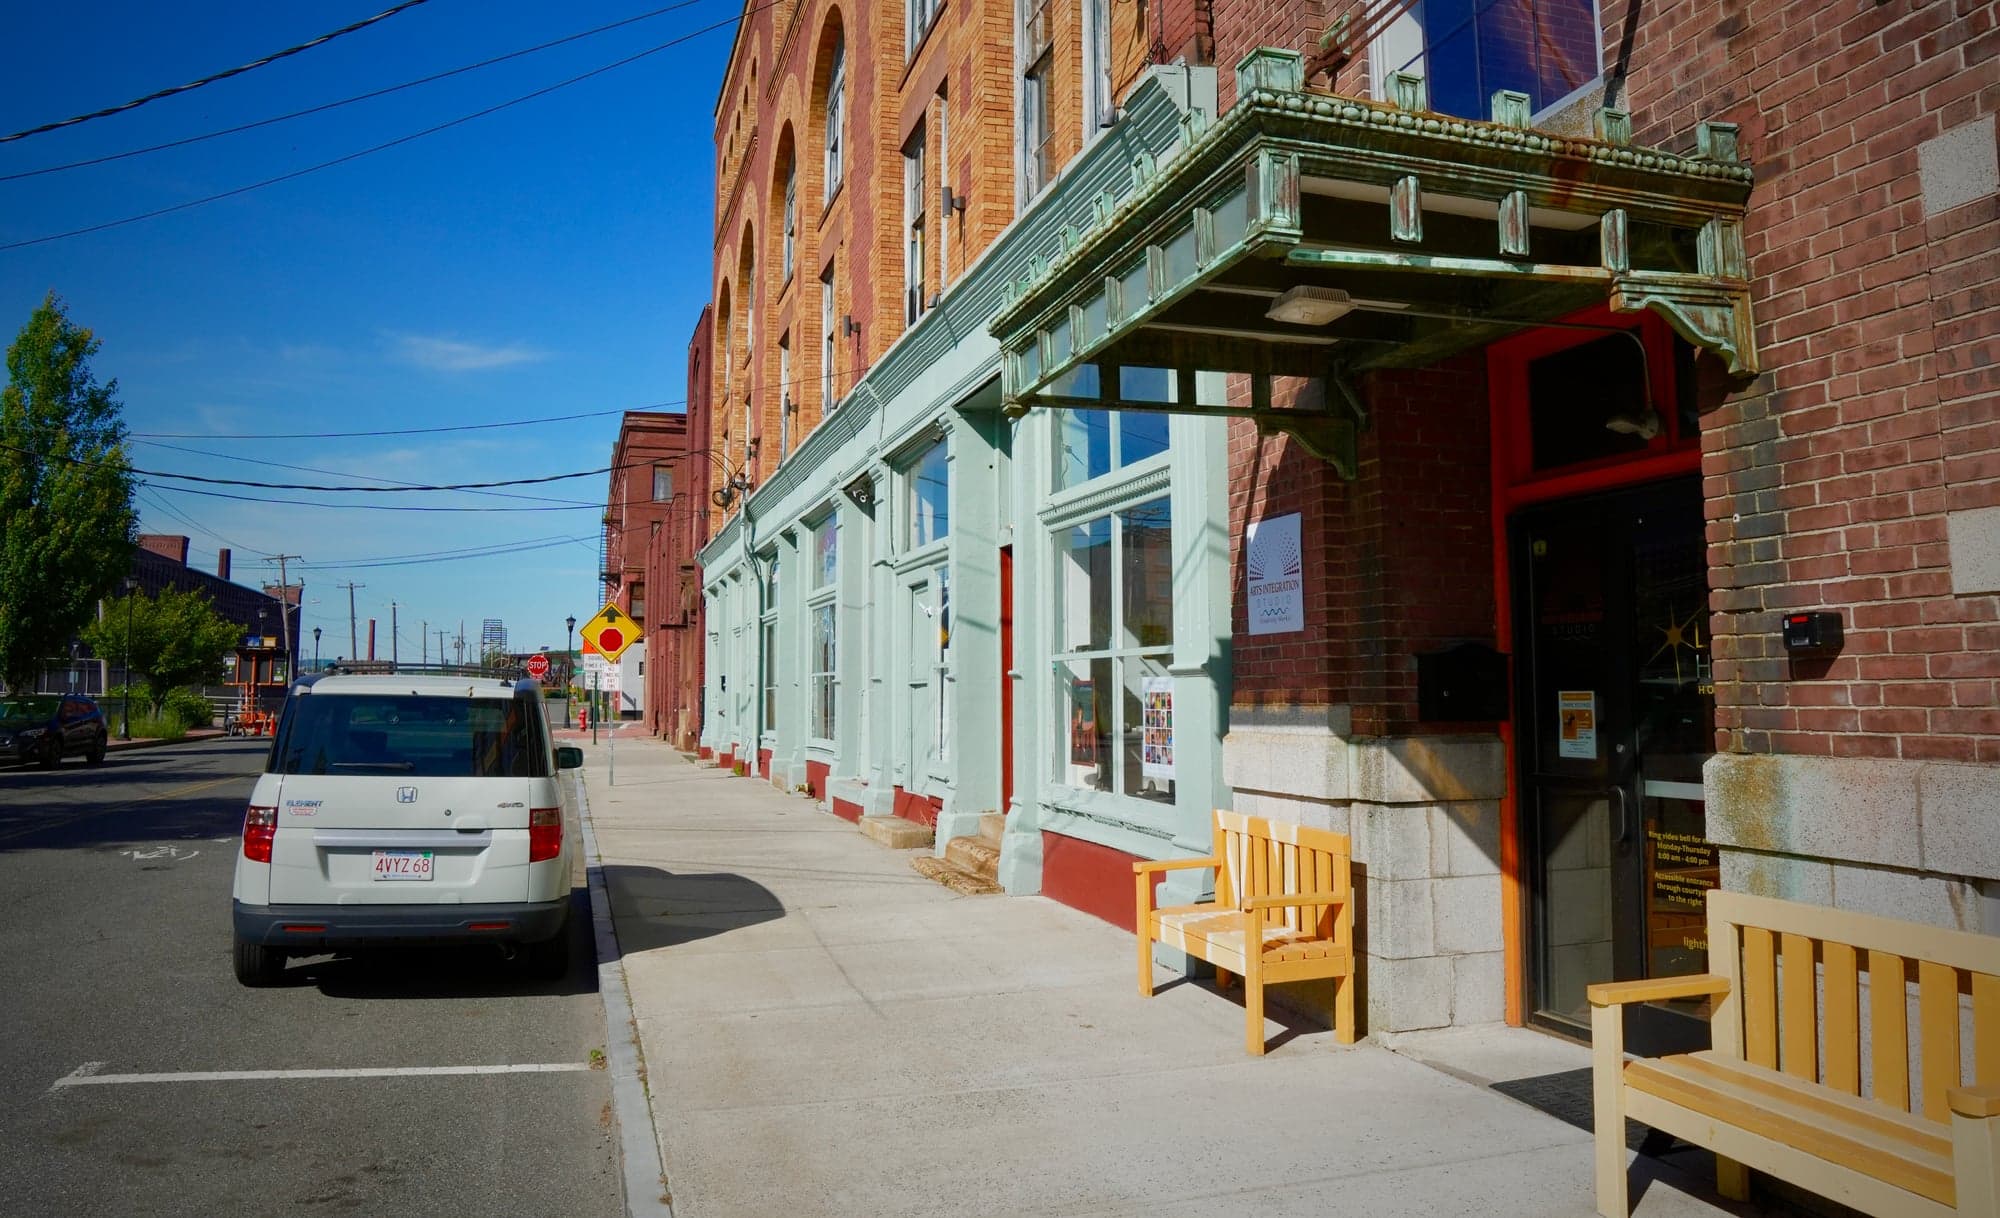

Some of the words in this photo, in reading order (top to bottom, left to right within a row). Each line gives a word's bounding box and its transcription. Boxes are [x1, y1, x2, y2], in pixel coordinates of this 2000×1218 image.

[1250, 584, 1262, 596] ARTS
[1262, 579, 1299, 594] INTEGRATION
[530, 661, 547, 669] STOP
[1662, 832, 1679, 841] video
[1680, 833, 1691, 842] bell
[1691, 835, 1701, 843] for
[1657, 841, 1711, 857] Monday-Thursday
[375, 858, 410, 873] 4VYZ
[413, 858, 430, 873] 68
[1685, 855, 1697, 864] 4:00
[1698, 859, 1709, 867] pm
[1655, 872, 1685, 882] Accessible
[1686, 877, 1714, 887] entrance
[1657, 882, 1681, 894] through
[1682, 887, 1707, 896] courtya
[1676, 895, 1686, 903] the
[1683, 936, 1709, 951] lighth
